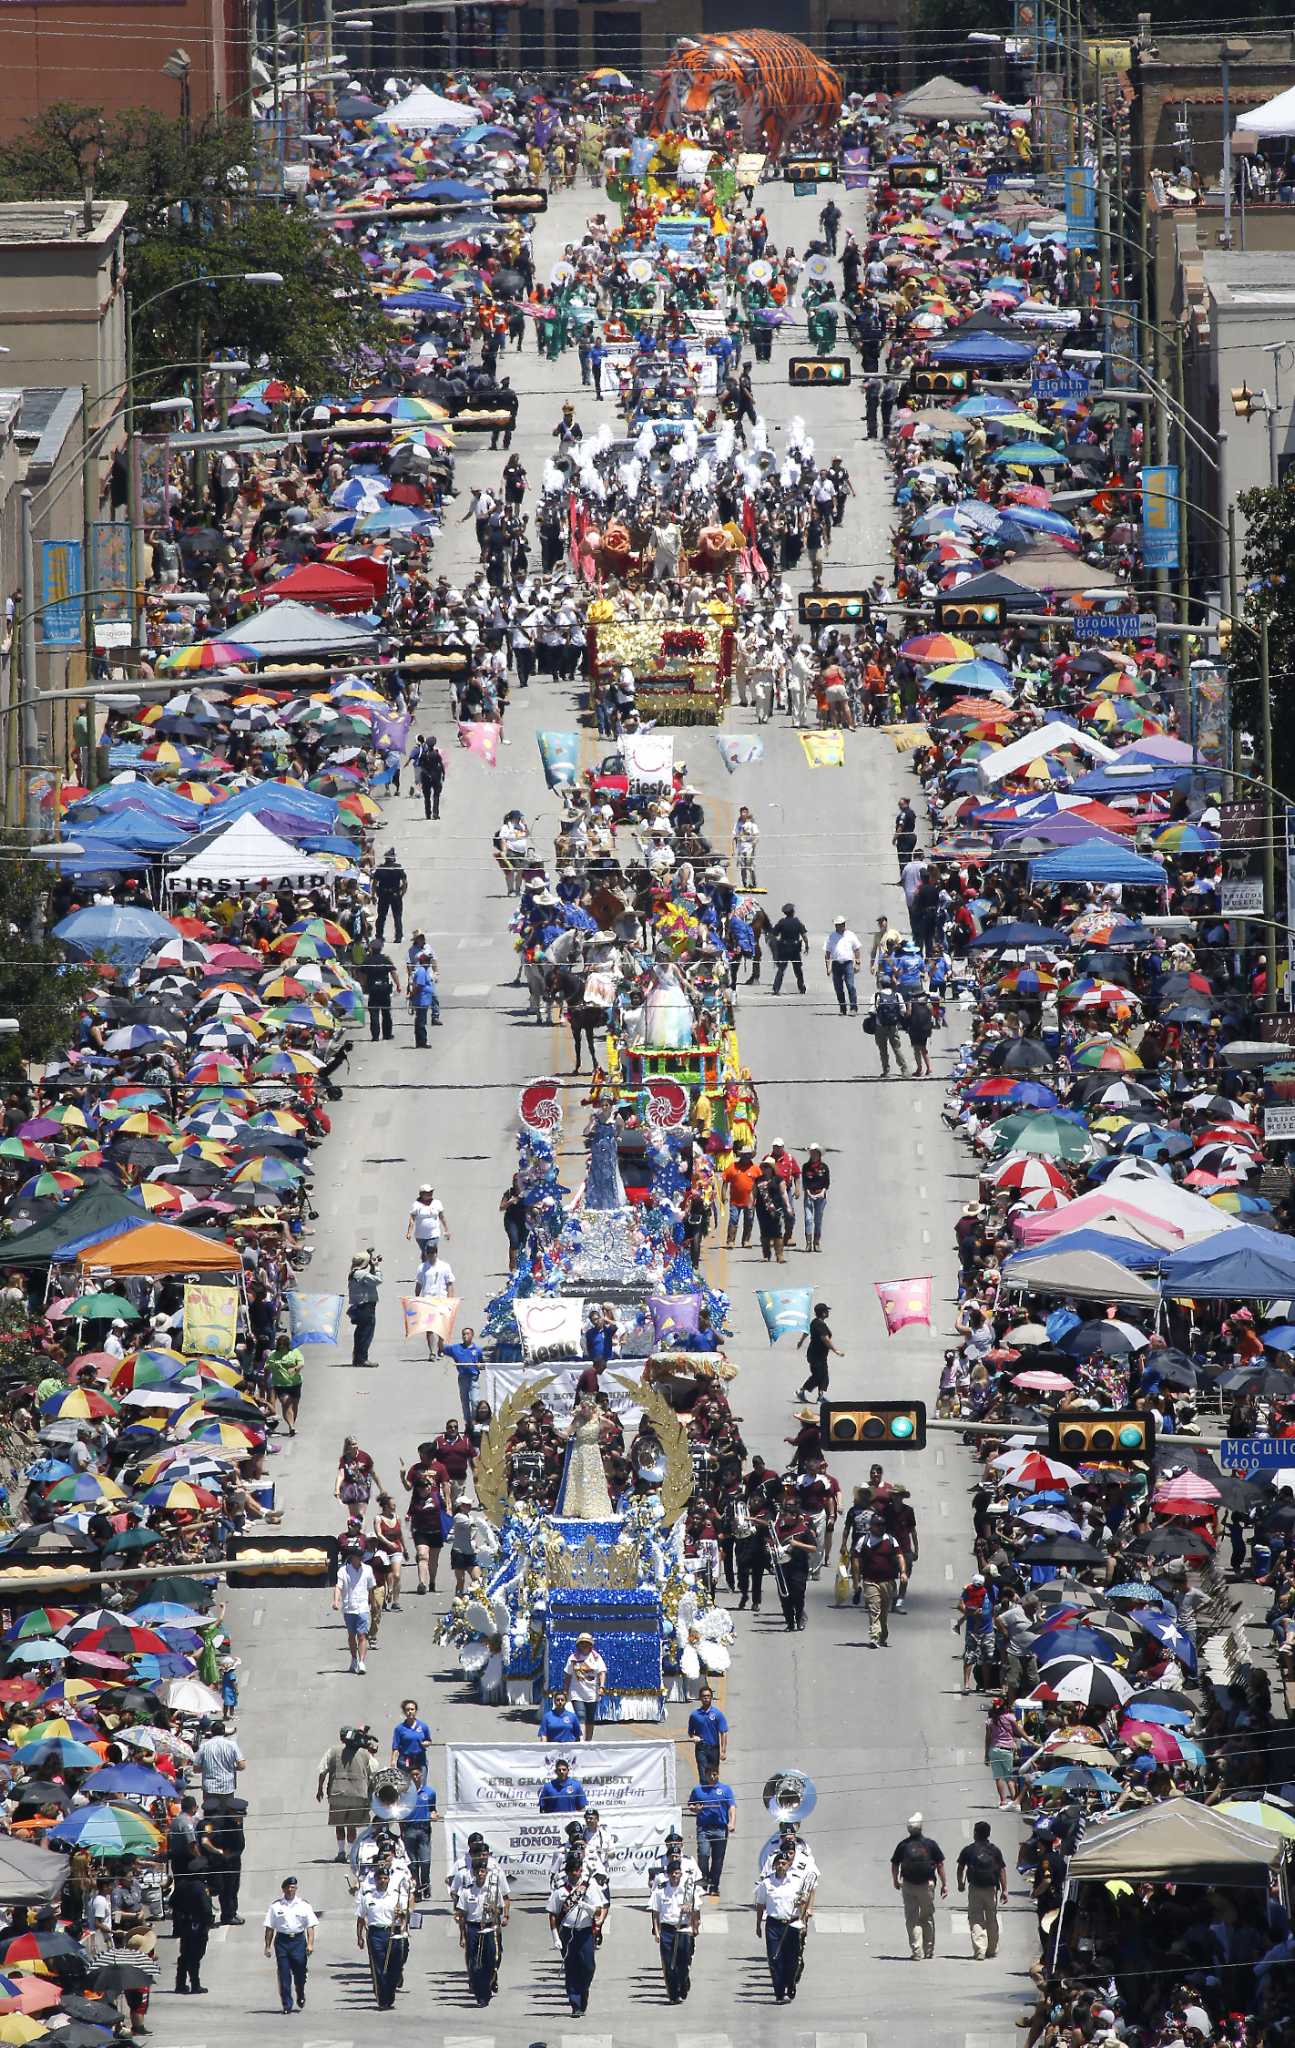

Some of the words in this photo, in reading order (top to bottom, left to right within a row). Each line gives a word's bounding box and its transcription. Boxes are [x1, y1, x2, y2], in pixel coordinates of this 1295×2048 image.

[1038, 379, 1082, 391] Eighth
[1077, 616, 1137, 630] Brooklyn
[169, 877, 250, 891] FIRST
[278, 875, 325, 889] AID
[582, 1775, 634, 1786] MAJESTY
[585, 1786, 645, 1799] arrington
[519, 1825, 560, 1835] ROYAL
[509, 1836, 562, 1848] HONOR
[517, 1851, 546, 1865] Jay
[615, 1846, 660, 1860] chool
